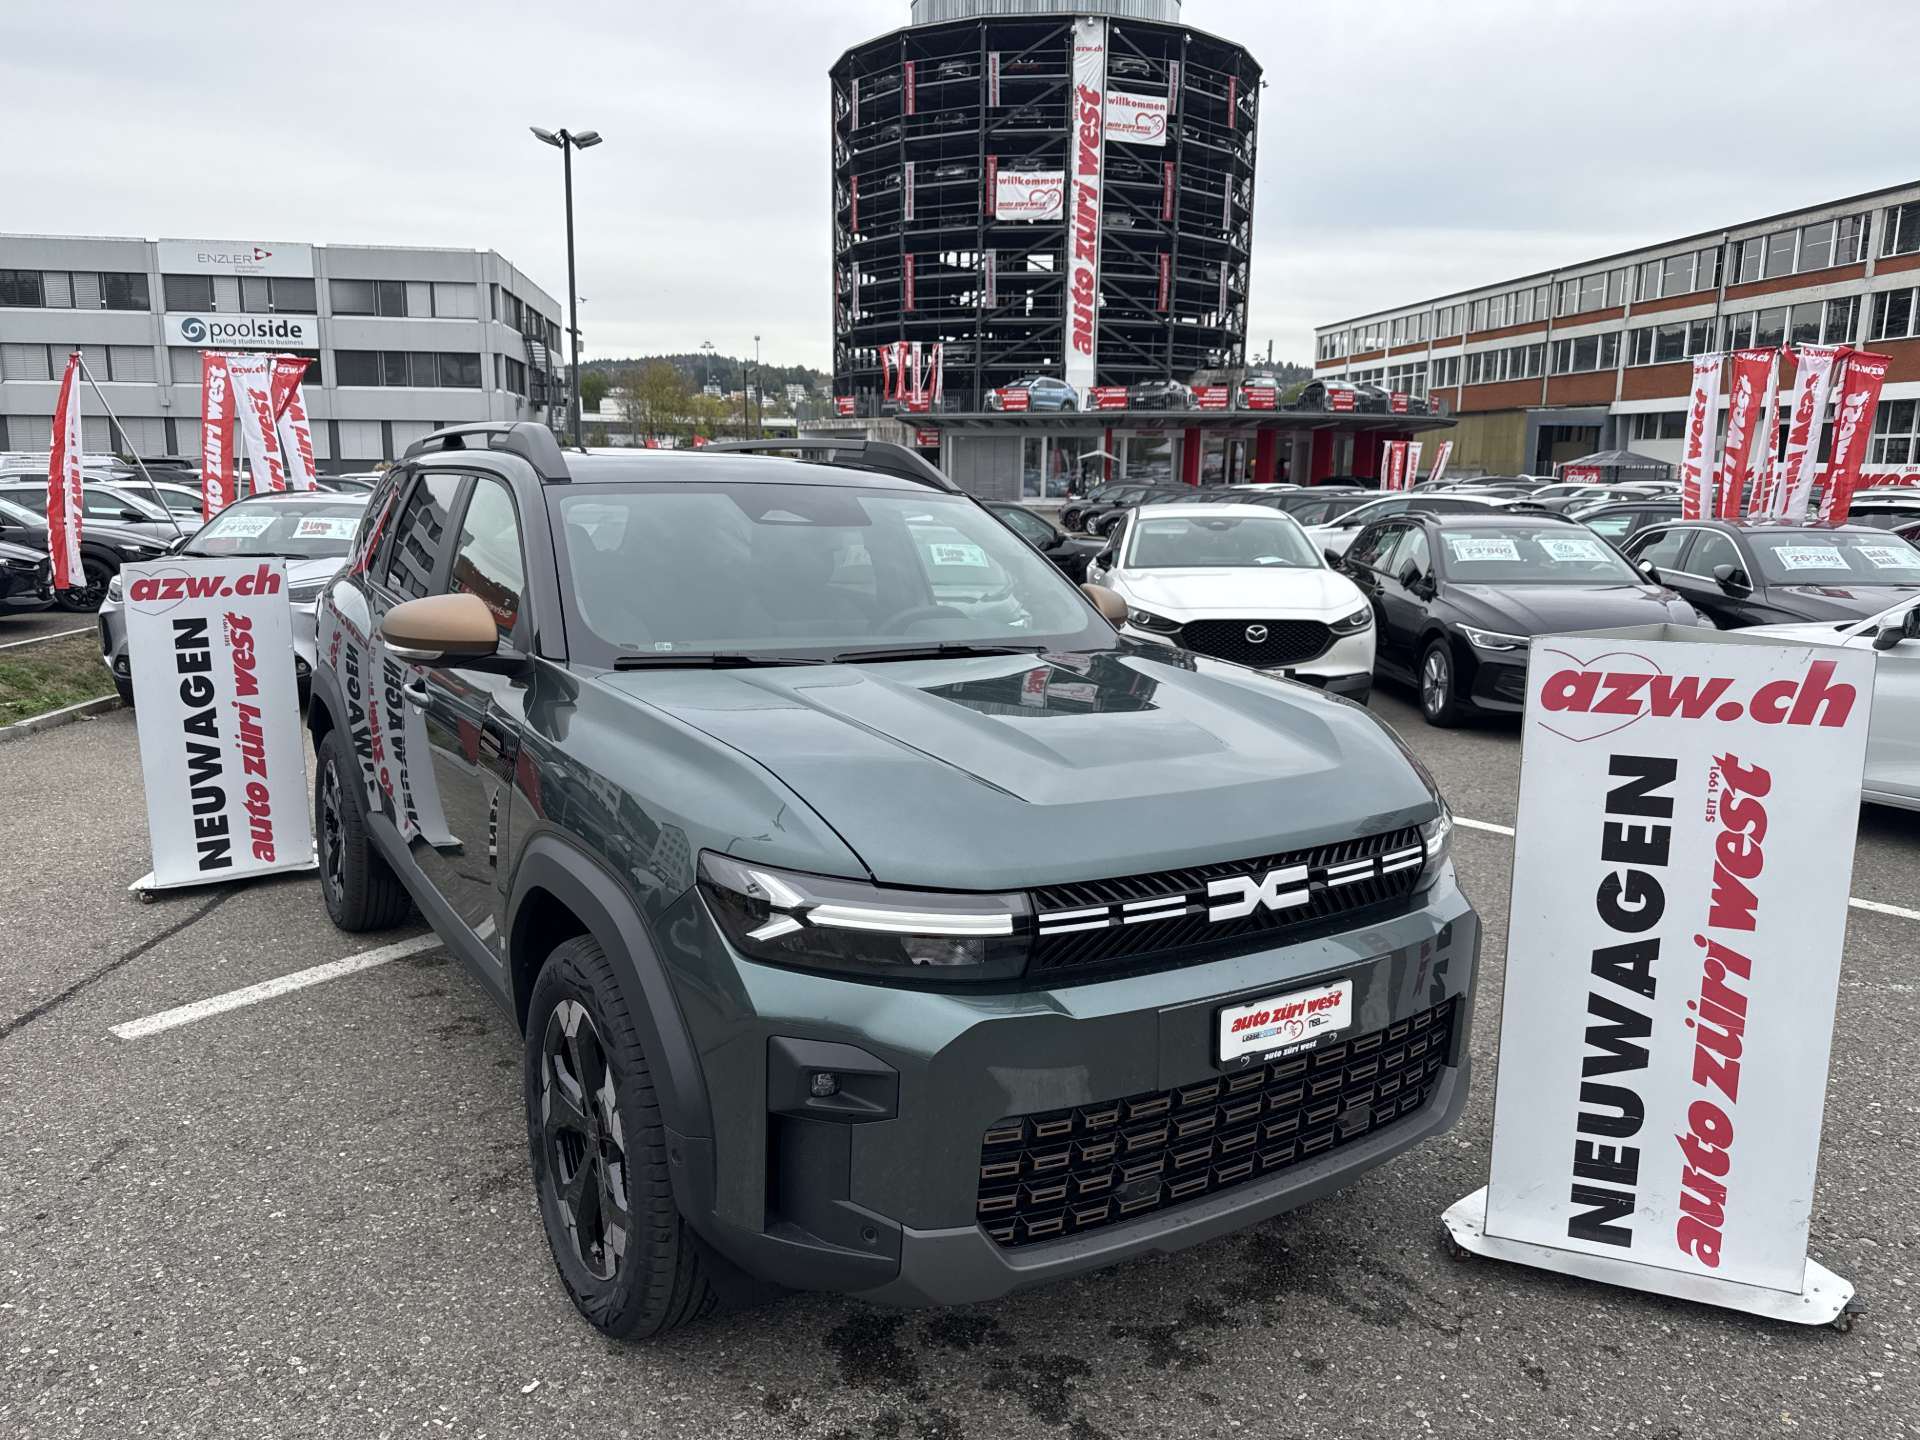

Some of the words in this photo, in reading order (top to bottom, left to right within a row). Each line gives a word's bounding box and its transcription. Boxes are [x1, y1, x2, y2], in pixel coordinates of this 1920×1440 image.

[1076, 84, 1101, 175] west
[1107, 96, 1166, 111] willkommen
[998, 176, 1062, 186] willkommen
[1072, 178, 1099, 267] züri
[197, 253, 252, 265] ENZLER
[209, 318, 303, 343] poolside
[215, 338, 237, 346] taking
[238, 338, 266, 346] students
[275, 338, 304, 346] business
[1071, 267, 1096, 355] auto
[207, 365, 227, 420] west
[231, 363, 267, 375] azw.ch
[248, 387, 280, 453] west
[130, 563, 281, 602] azw.ch
[222, 611, 260, 697] west
[1540, 660, 1857, 729] azw.ch
[172, 617, 233, 872] NEUWAGEN
[231, 701, 268, 780] züri
[1704, 795, 1717, 824] SEIT
[1707, 765, 1720, 794] 1991
[242, 781, 276, 864] auto
[1708, 751, 1773, 932] west
[1231, 1010, 1271, 1033] auto
[1271, 999, 1306, 1024] züri
[1307, 991, 1344, 1014] west
[1567, 753, 1679, 1249] NEUWAGEN
[1684, 933, 1753, 1105] züri
[1263, 1050, 1282, 1061] auto
[1283, 1045, 1299, 1056] züri
[1300, 1039, 1318, 1051] west
[1675, 1099, 1735, 1270] auto
